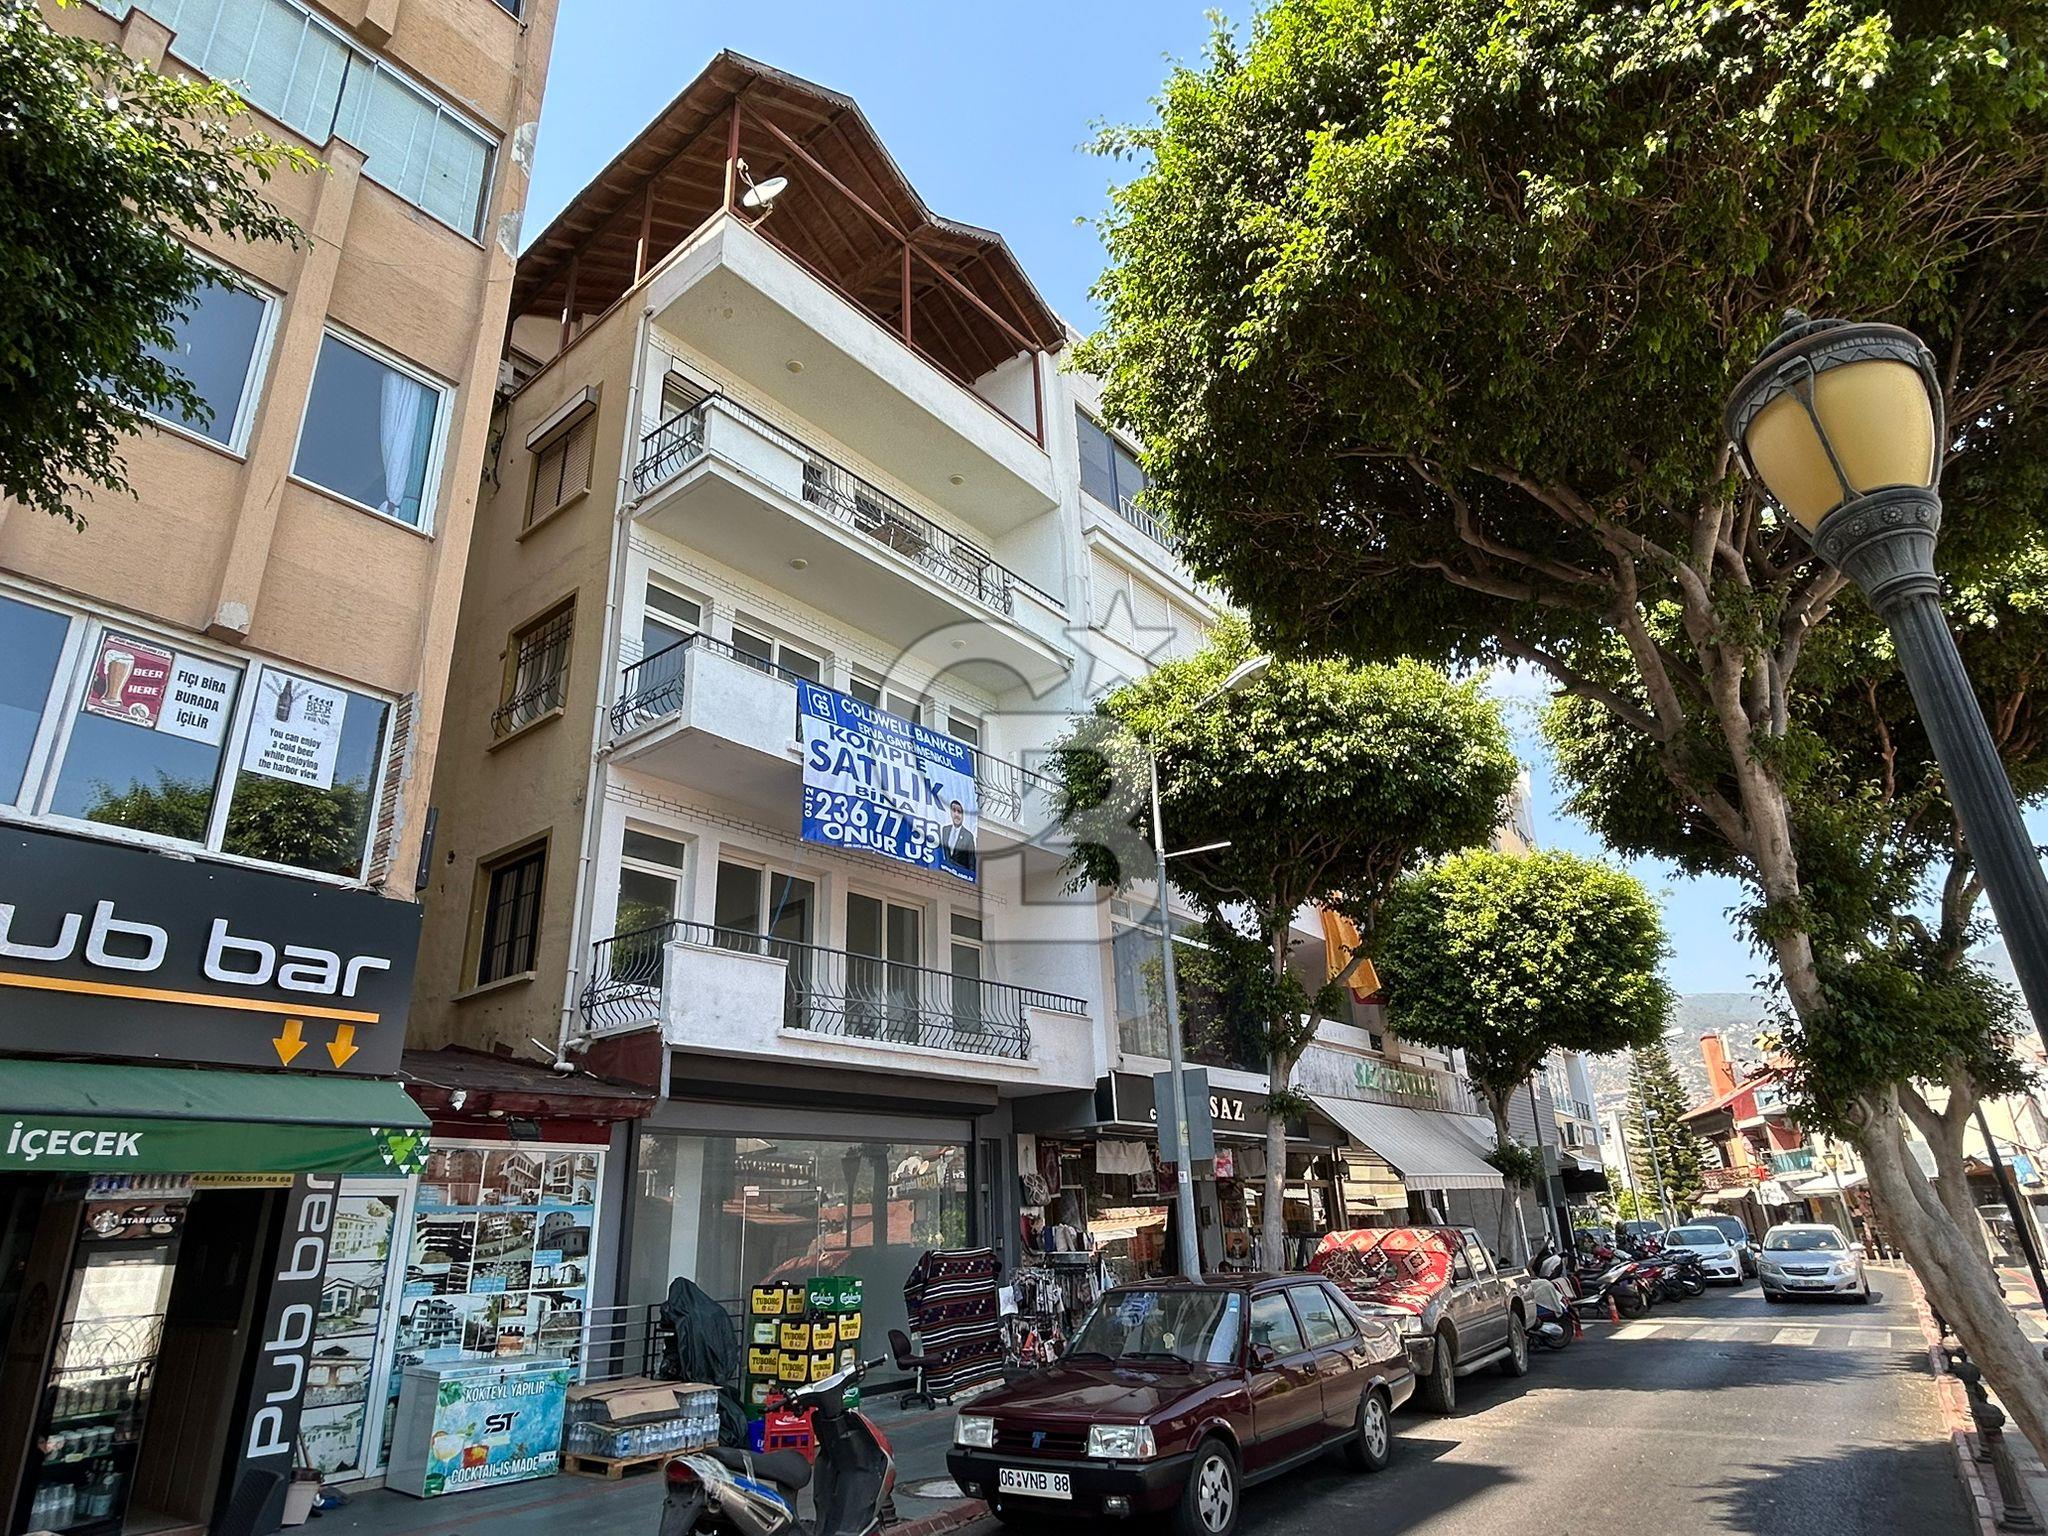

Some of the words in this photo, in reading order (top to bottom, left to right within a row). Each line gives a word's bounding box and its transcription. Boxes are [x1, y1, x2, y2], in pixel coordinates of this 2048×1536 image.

[133, 667, 165, 680] BEER
[177, 670, 199, 688] FIÇI
[200, 676, 227, 694] BİRA
[127, 684, 160, 697] HERE
[175, 690, 220, 712] BURADA
[176, 708, 209, 729] İÇİLİR
[840, 698, 914, 739] COLDWELL
[914, 728, 965, 760] BANKER
[269, 727, 284, 739] You
[284, 732, 300, 743] can
[300, 737, 322, 750] enjoy
[857, 721, 885, 742] ERVA
[264, 749, 286, 761] while
[286, 754, 319, 771] enjoying
[272, 740, 278, 749] a
[278, 741, 296, 752] cold
[297, 745, 315, 758] beer
[829, 725, 927, 774] KOMPLE
[258, 758, 272, 769] the
[272, 761, 299, 776] harbor
[300, 768, 320, 782] view.
[809, 738, 946, 811] SATILIK
[804, 786, 814, 818] 0312
[814, 791, 869, 827] 236
[873, 805, 904, 838] 77
[910, 818, 941, 849] 55
[822, 822, 898, 854] ONUR
[904, 842, 935, 863] US
[203, 917, 392, 998] bar
[1209, 1095, 1246, 1122] SAZ
[6, 1121, 144, 1162] İÇECEK
[121, 1215, 177, 1225] STARBUCKS
[277, 1173, 335, 1282] bar
[755, 1297, 780, 1305] TUBORG
[784, 1331, 806, 1341] TUBORG
[752, 1356, 777, 1366] TUBORG
[781, 1362, 805, 1372] TUBORG
[464, 1385, 508, 1403] KOKTEYL
[511, 1380, 546, 1397] YAPILIR
[451, 1464, 497, 1484] COCKTAIL
[511, 1455, 540, 1474] MADE
[1000, 1469, 1015, 1487] 06
[1021, 1472, 1047, 1490] VNB
[1053, 1475, 1069, 1492] 88
